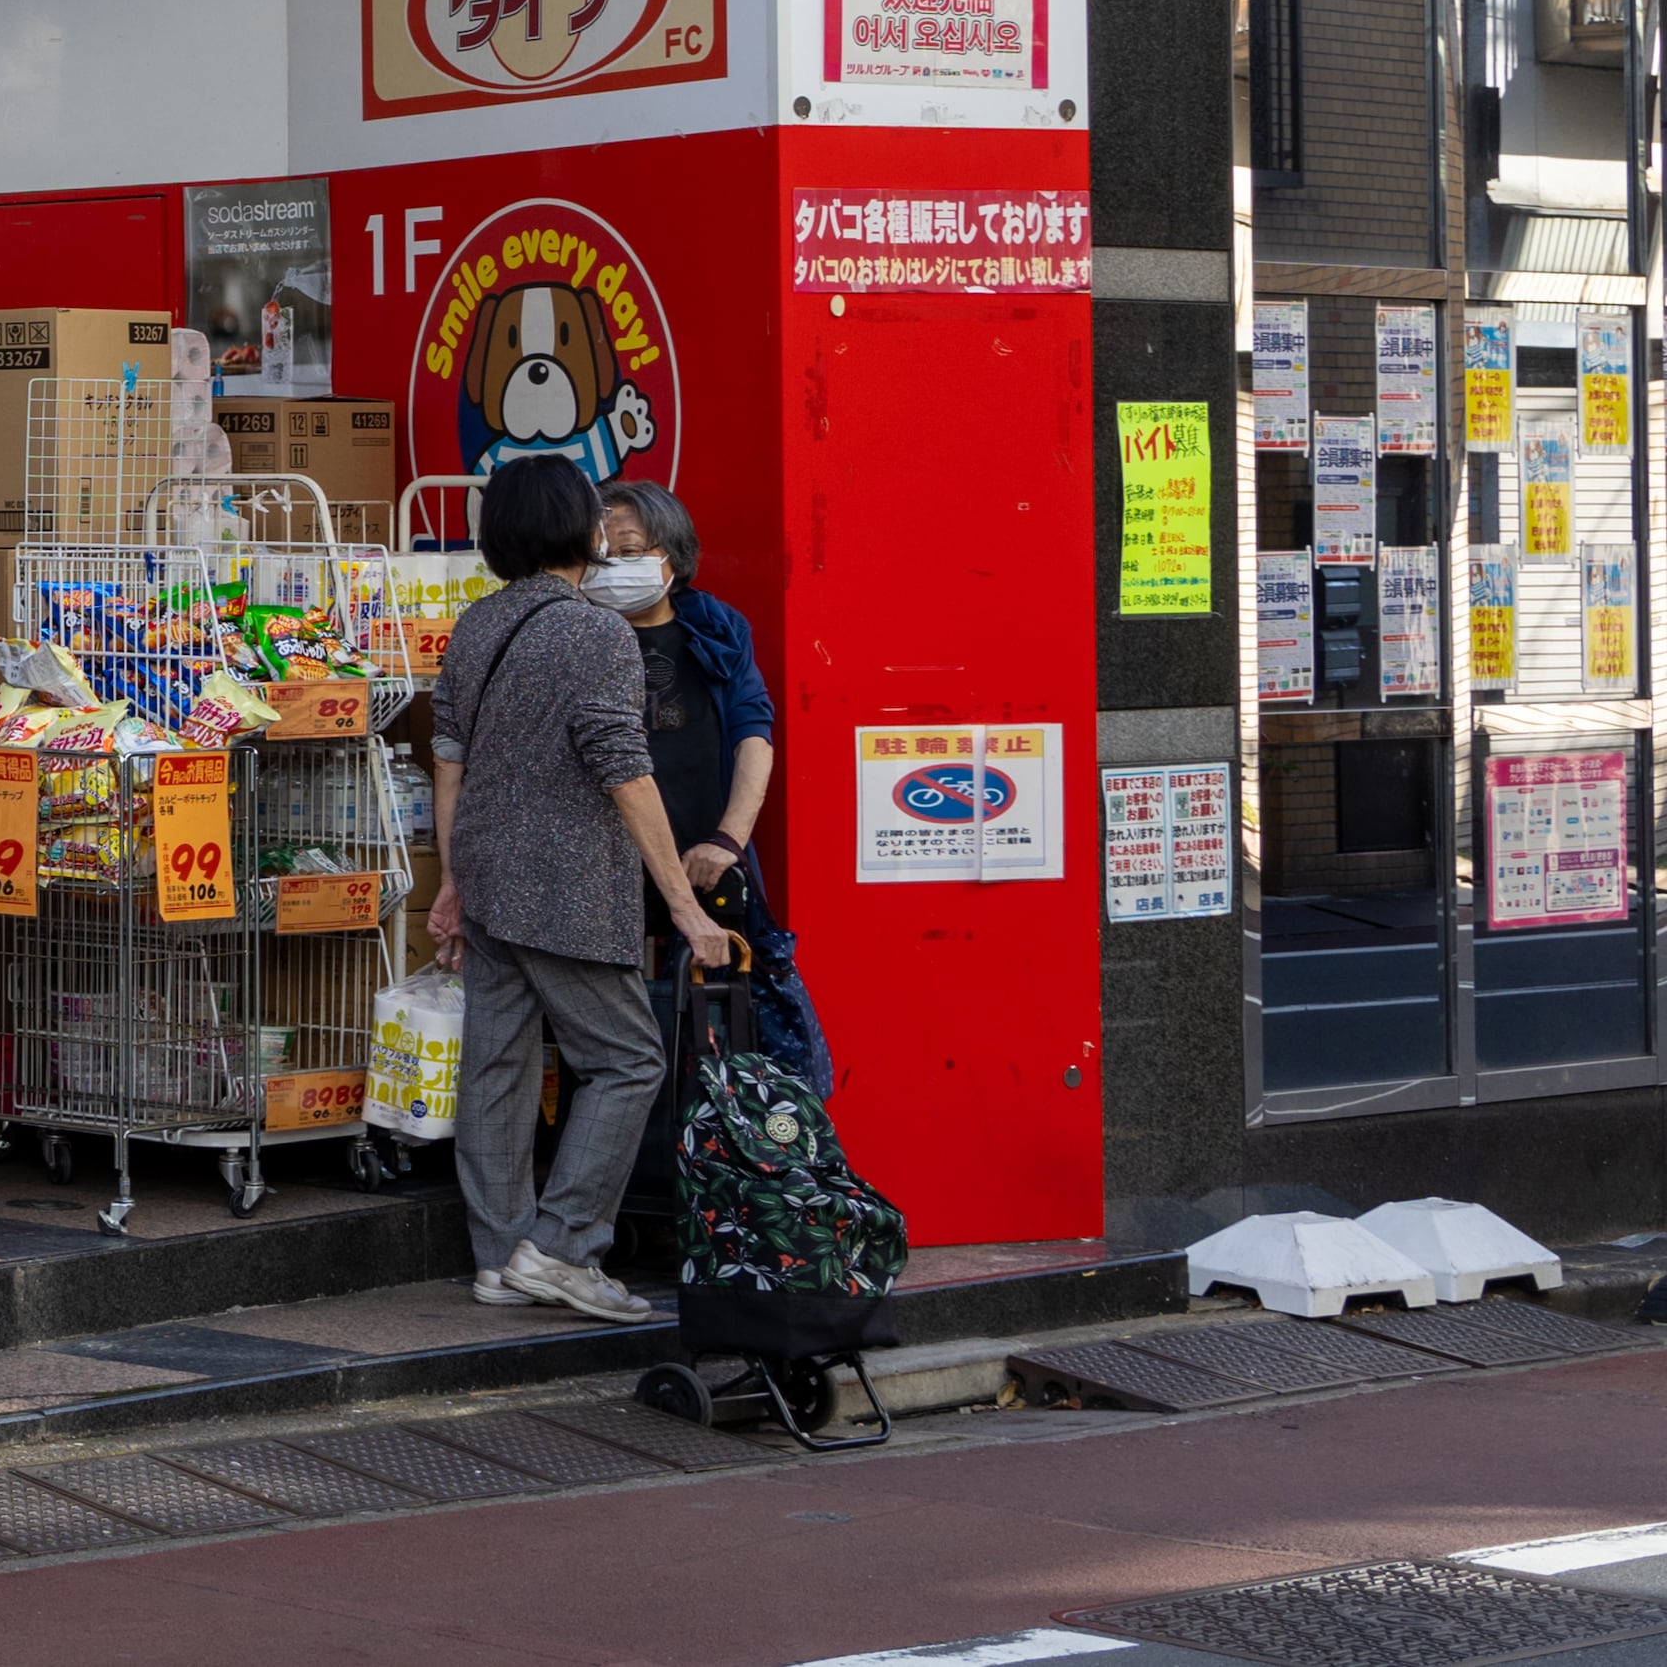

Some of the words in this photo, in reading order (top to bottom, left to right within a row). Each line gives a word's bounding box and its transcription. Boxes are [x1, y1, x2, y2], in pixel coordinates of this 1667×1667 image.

[665, 24, 703, 59] FC
[853, 16, 910, 53] 어서
[913, 18, 1023, 56] 오십시오
[207, 199, 315, 224] sodastream
[793, 198, 1089, 245] タバコ各種販売しております
[364, 206, 444, 296] 1F
[793, 254, 1092, 290] タバコのお求めはレジにてお願い致します
[427, 254, 499, 379] Smile
[502, 228, 598, 287] every
[596, 262, 660, 371] day!
[132, 325, 164, 342] 33267
[219, 412, 275, 433] 41269
[352, 411, 390, 429] 41269
[1124, 423, 1206, 464] バイト募集
[317, 697, 361, 718] 89
[158, 756, 226, 786] 今月のお買得品
[1170, 773, 1225, 788] 自転車でご来店の
[1105, 777, 1163, 792] 自転車でご来店の
[1126, 792, 1164, 806] お客様への
[1126, 807, 1160, 821] お願い
[1190, 803, 1222, 818] お願い
[875, 827, 1032, 838] 近隣の皆さまのご迷惑と
[1107, 826, 1164, 842] 恐れ入りますが
[170, 842, 222, 882] 99
[188, 883, 217, 900] 106
[1198, 891, 1225, 907] 店長
